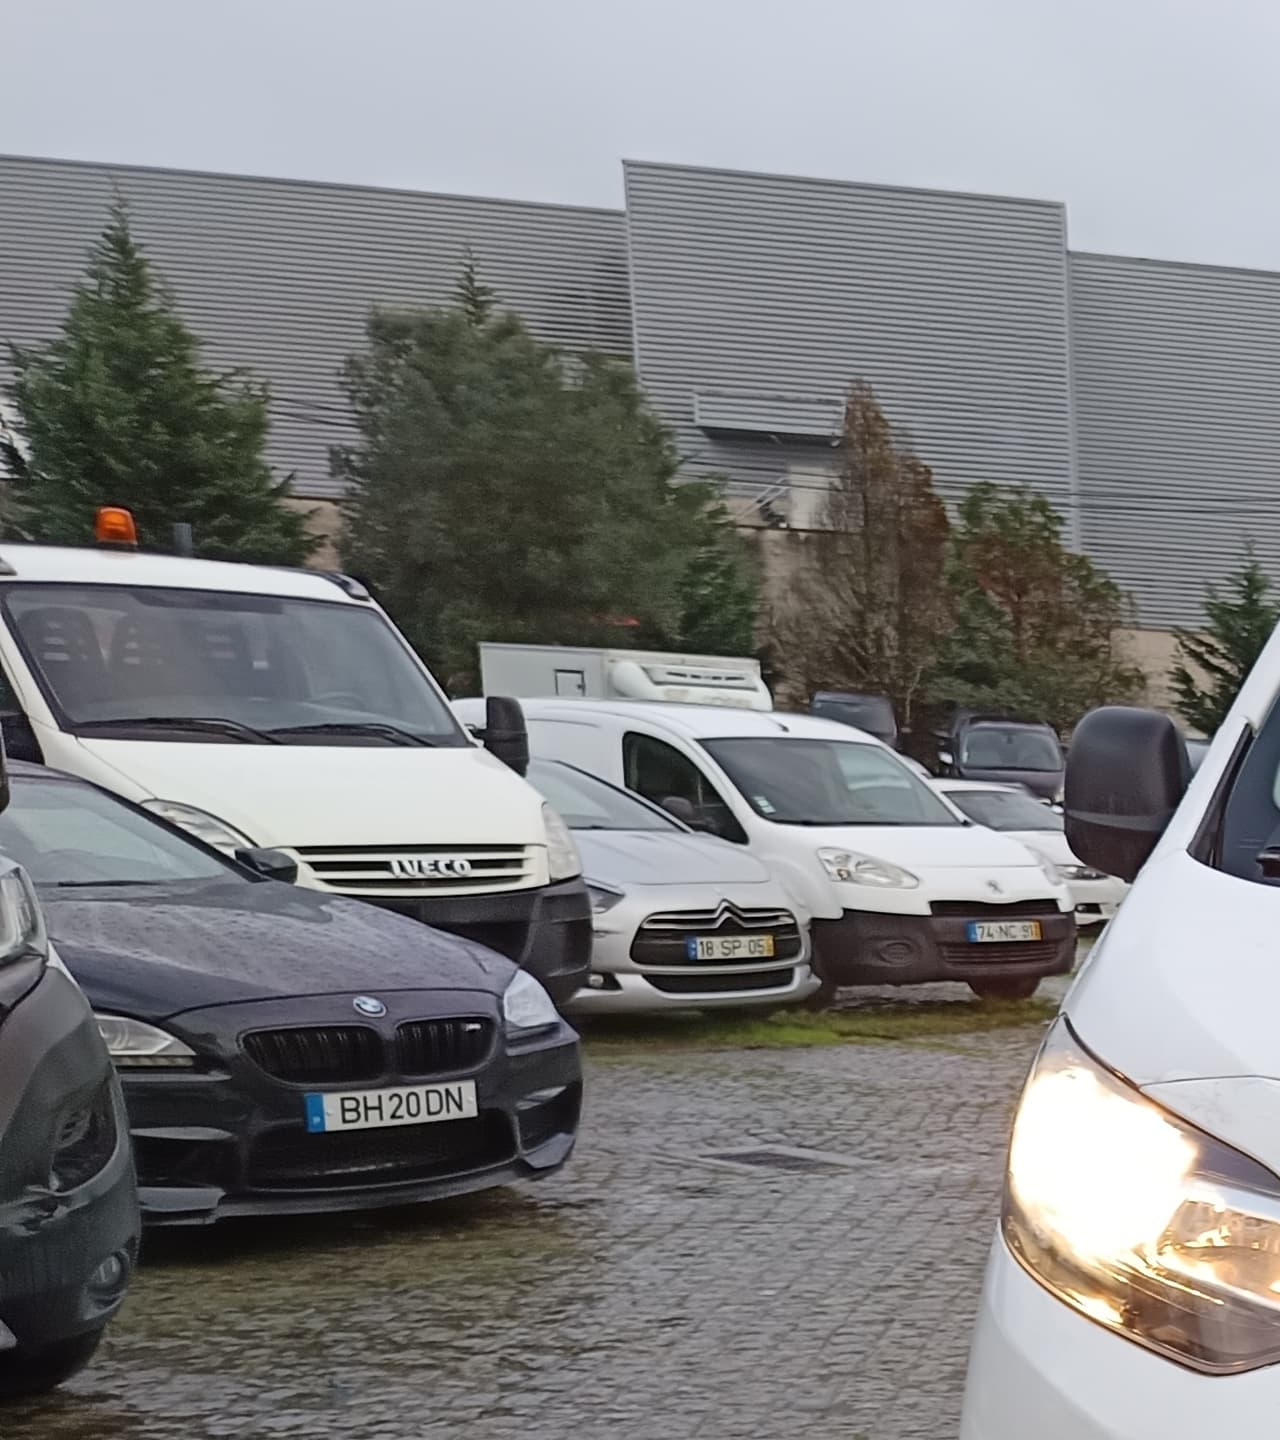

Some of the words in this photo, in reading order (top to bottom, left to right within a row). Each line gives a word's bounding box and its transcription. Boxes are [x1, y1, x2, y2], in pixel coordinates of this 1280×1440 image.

[390, 859, 472, 877] IVECO
[340, 1095, 384, 1124] BH
[388, 1091, 421, 1120] 20
[425, 1086, 463, 1116] DN
